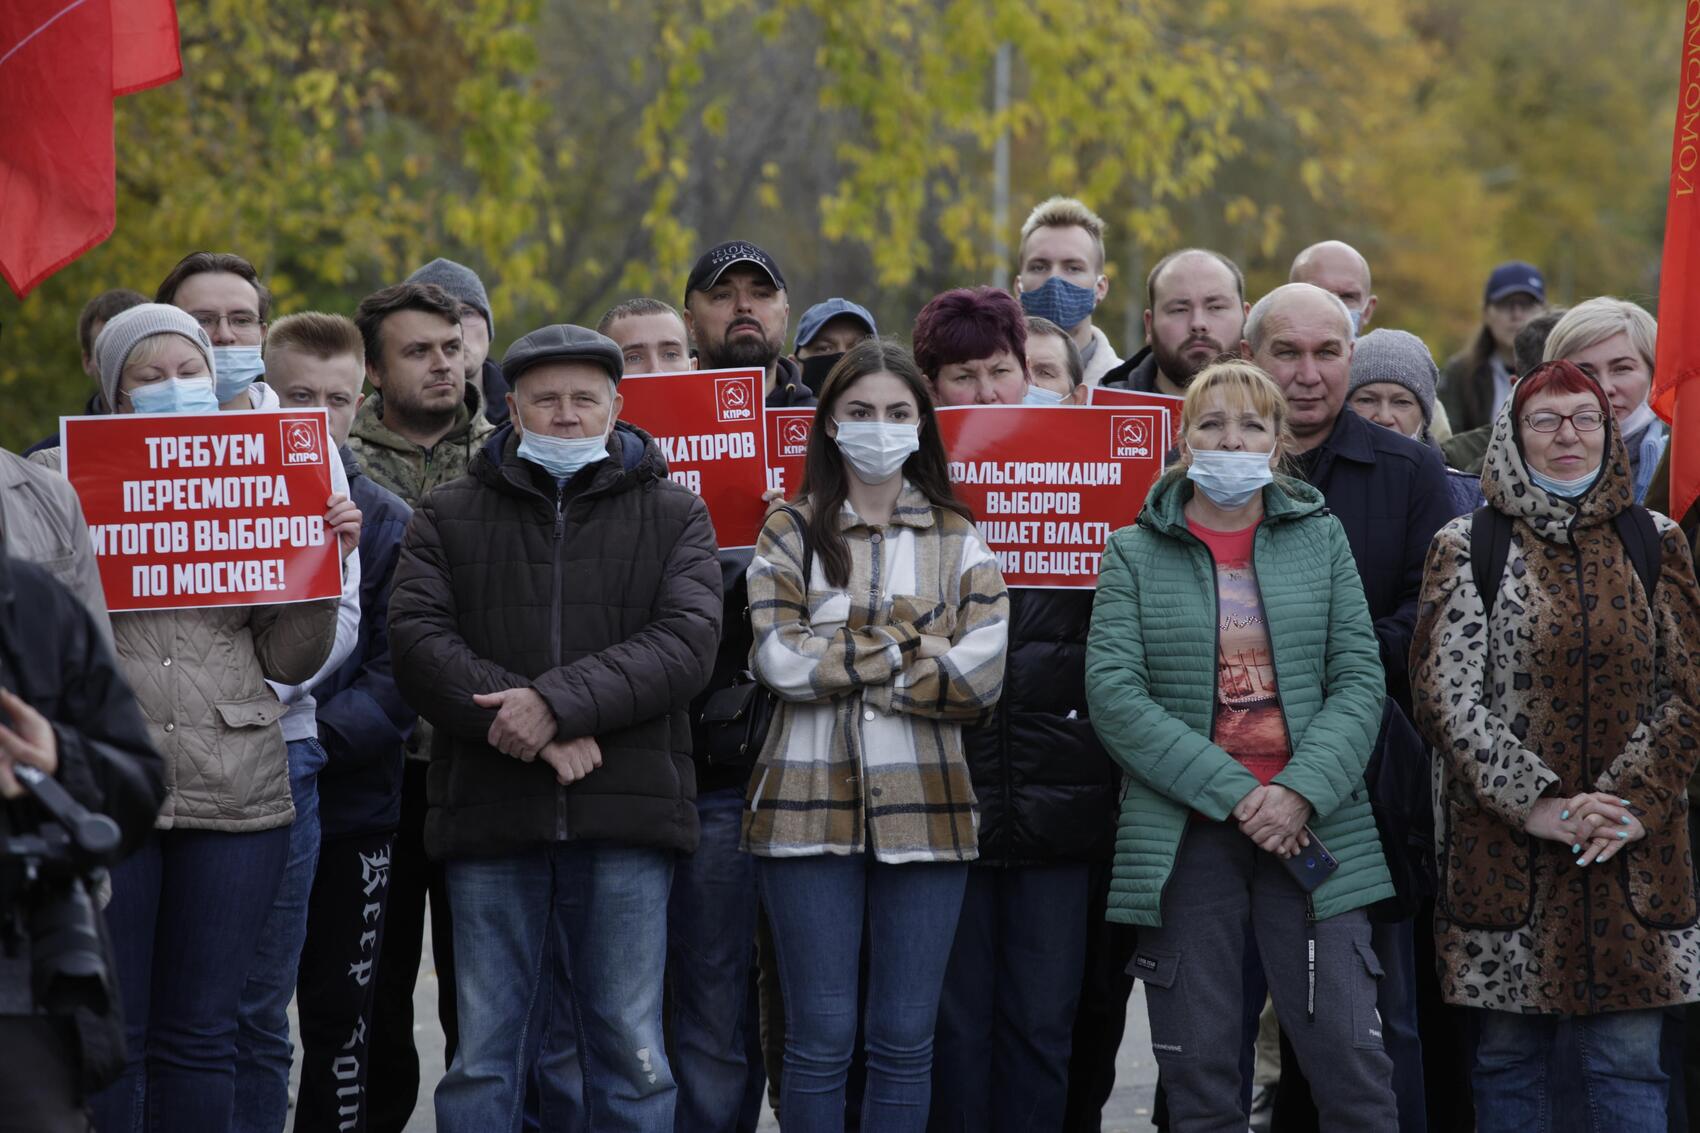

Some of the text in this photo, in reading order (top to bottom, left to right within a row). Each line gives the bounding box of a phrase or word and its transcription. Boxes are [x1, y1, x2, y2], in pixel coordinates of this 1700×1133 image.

[723, 409, 751, 420] КПРФ
[145, 433, 265, 469] ТРЕБУЕМ
[288, 452, 319, 464] КПРФ
[1117, 447, 1149, 457] КПРФ
[948, 461, 1122, 486] ФАЛЬСИФИКАЦИЯ
[123, 475, 290, 513] ПЕРЕСМОТРА
[986, 491, 1081, 514] ВЫБОРОВ
[89, 515, 325, 556] ИТОГОВ ВЫБОРОВ
[975, 521, 1041, 544] ИШАЕТ
[1024, 551, 1103, 576] ОБЩЕСТ
[132, 559, 287, 597] ПО МОСКВЕ!
